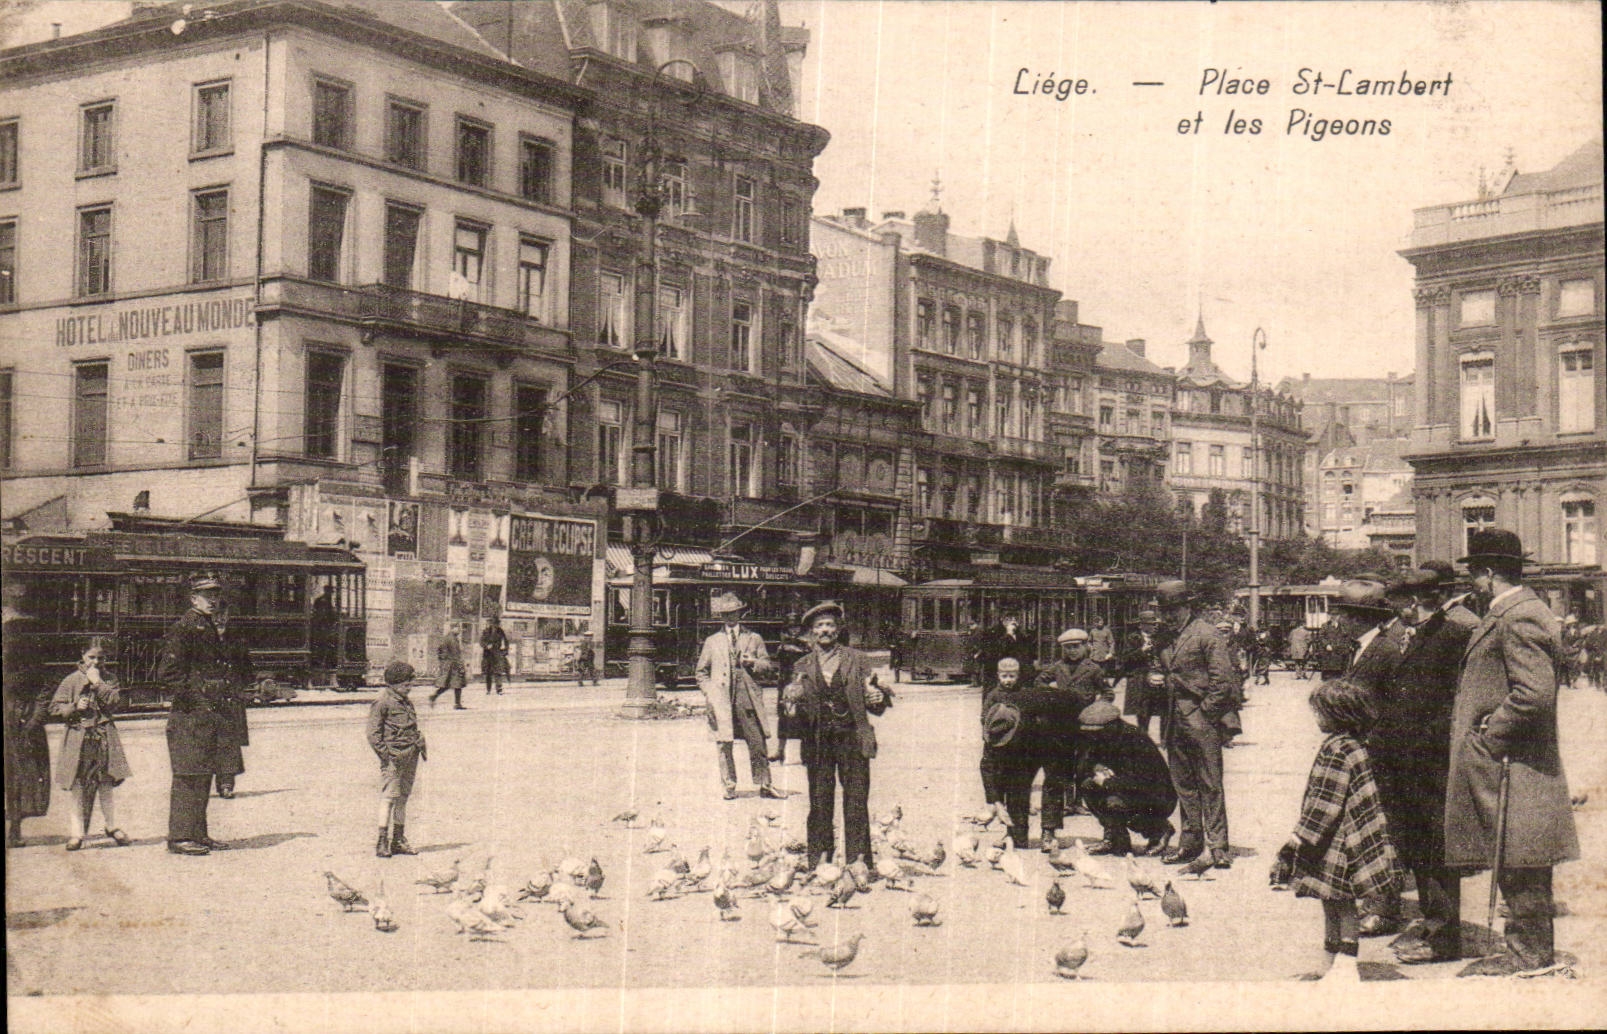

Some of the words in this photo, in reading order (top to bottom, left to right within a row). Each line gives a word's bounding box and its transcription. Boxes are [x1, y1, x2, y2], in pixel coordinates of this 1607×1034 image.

[119, 303, 194, 342] NOUVEAU
[197, 297, 255, 333] MONDE
[732, 564, 759, 579] LUX
